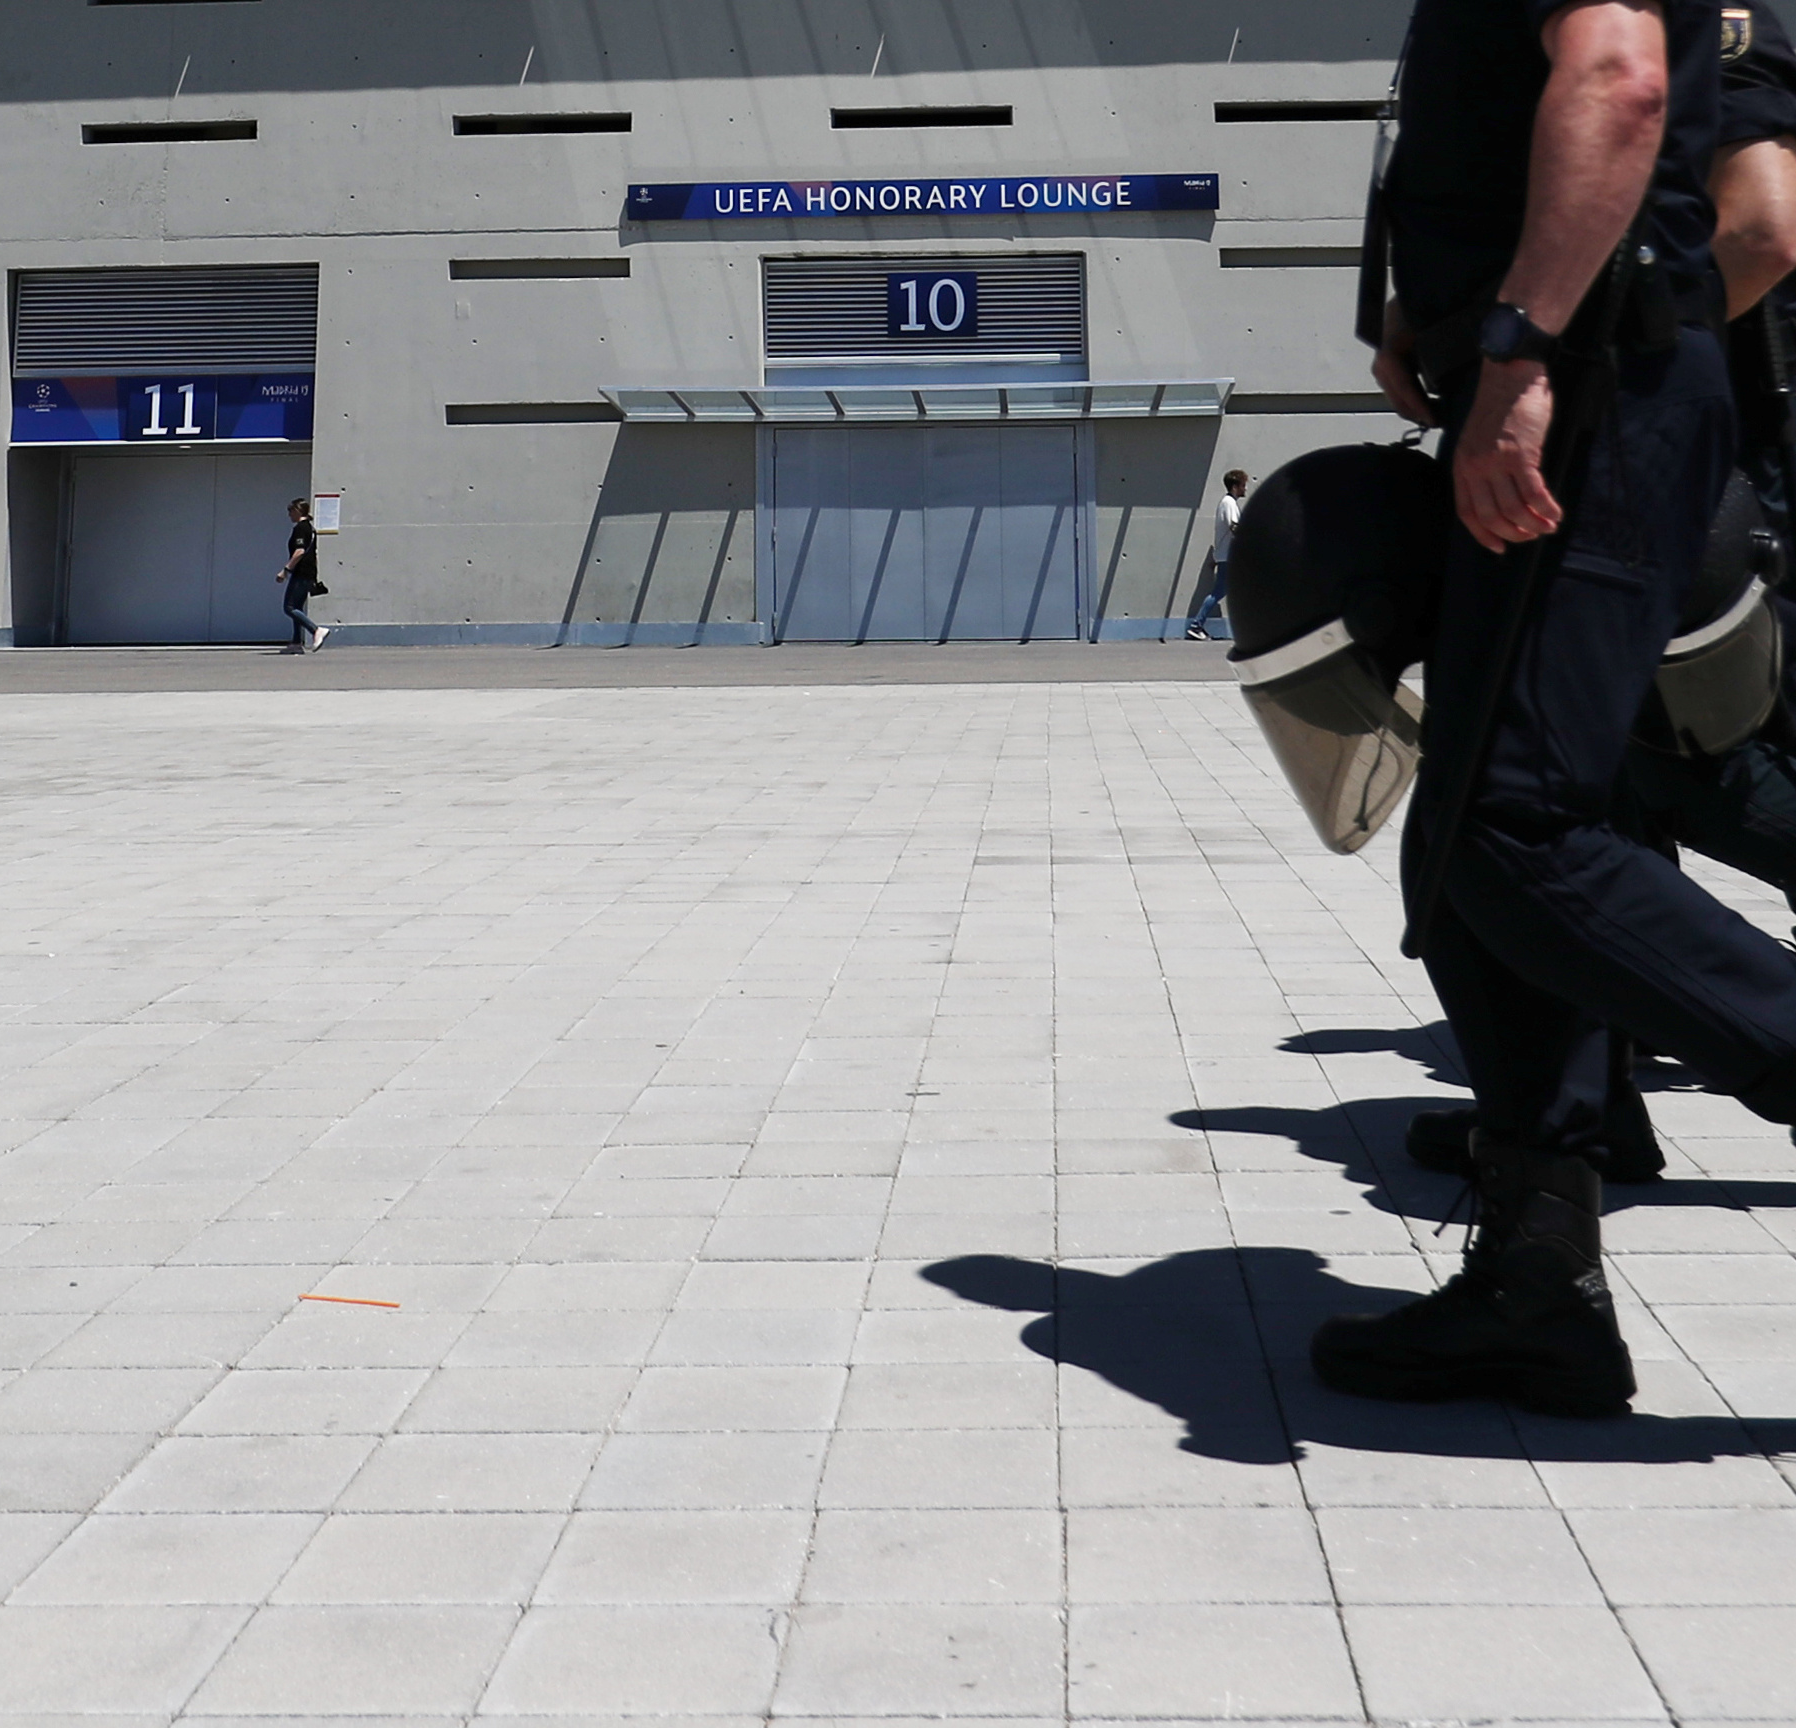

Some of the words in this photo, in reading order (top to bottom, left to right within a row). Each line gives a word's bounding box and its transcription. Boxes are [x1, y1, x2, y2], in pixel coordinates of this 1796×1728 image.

[715, 187, 793, 213] UEFA
[806, 184, 987, 211] HONORARY
[1001, 181, 1132, 208] LOUNGE
[900, 278, 966, 332] 10
[142, 383, 202, 435] 11
